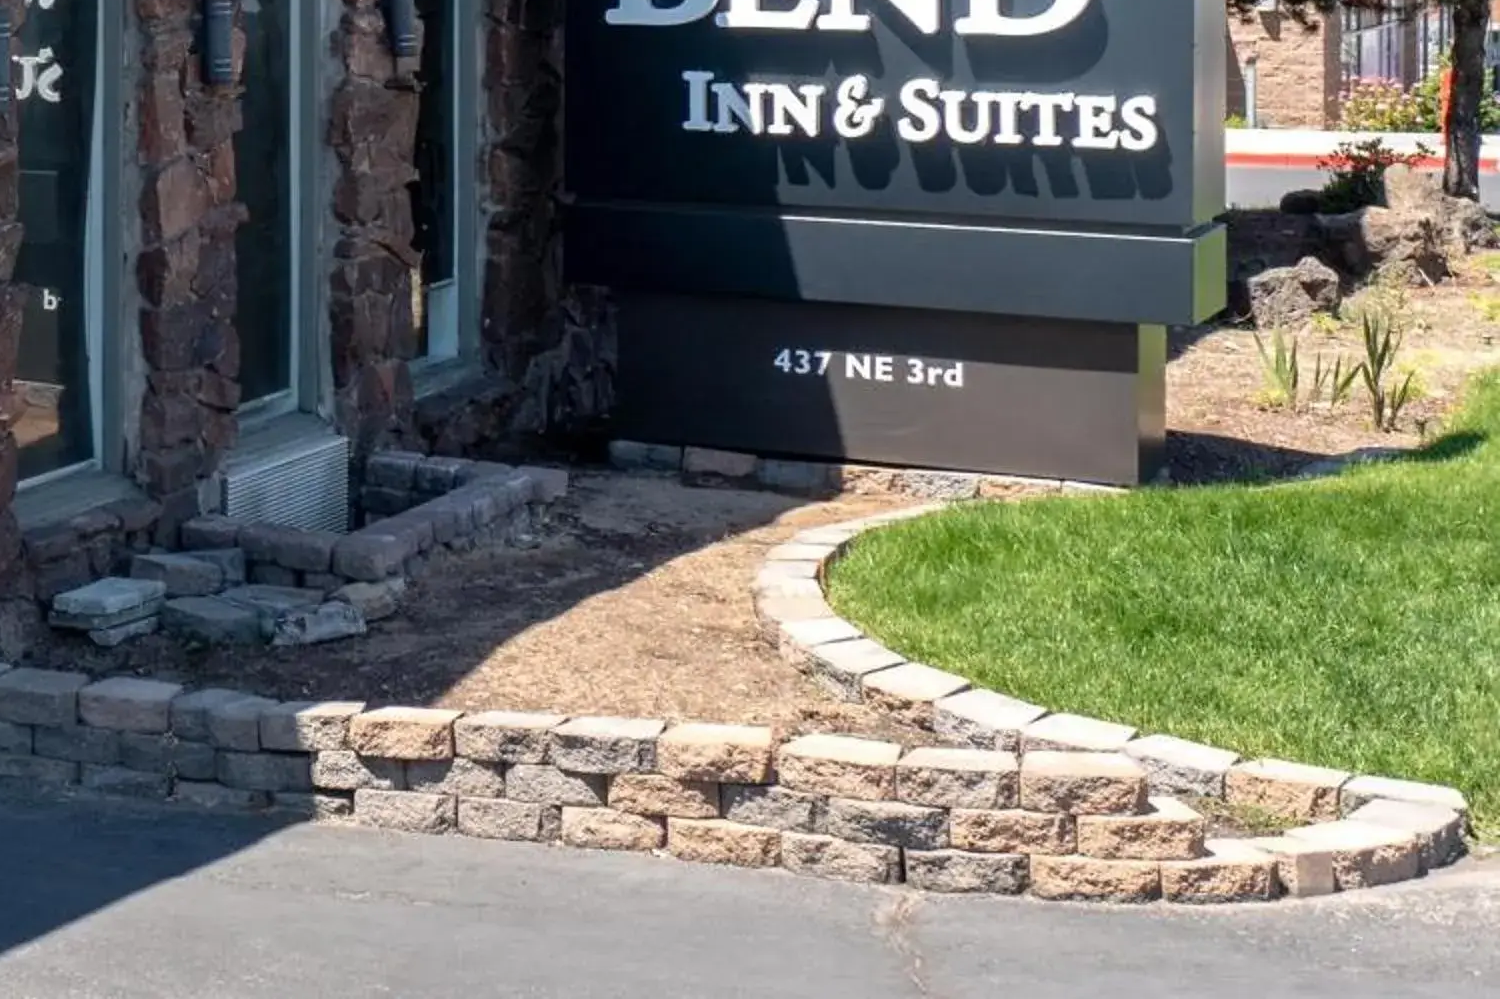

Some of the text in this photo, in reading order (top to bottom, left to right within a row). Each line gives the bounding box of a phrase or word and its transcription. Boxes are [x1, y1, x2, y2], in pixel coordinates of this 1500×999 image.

[681, 70, 1158, 152] INN & SUITES
[773, 348, 964, 388] 437 NE 3rd
